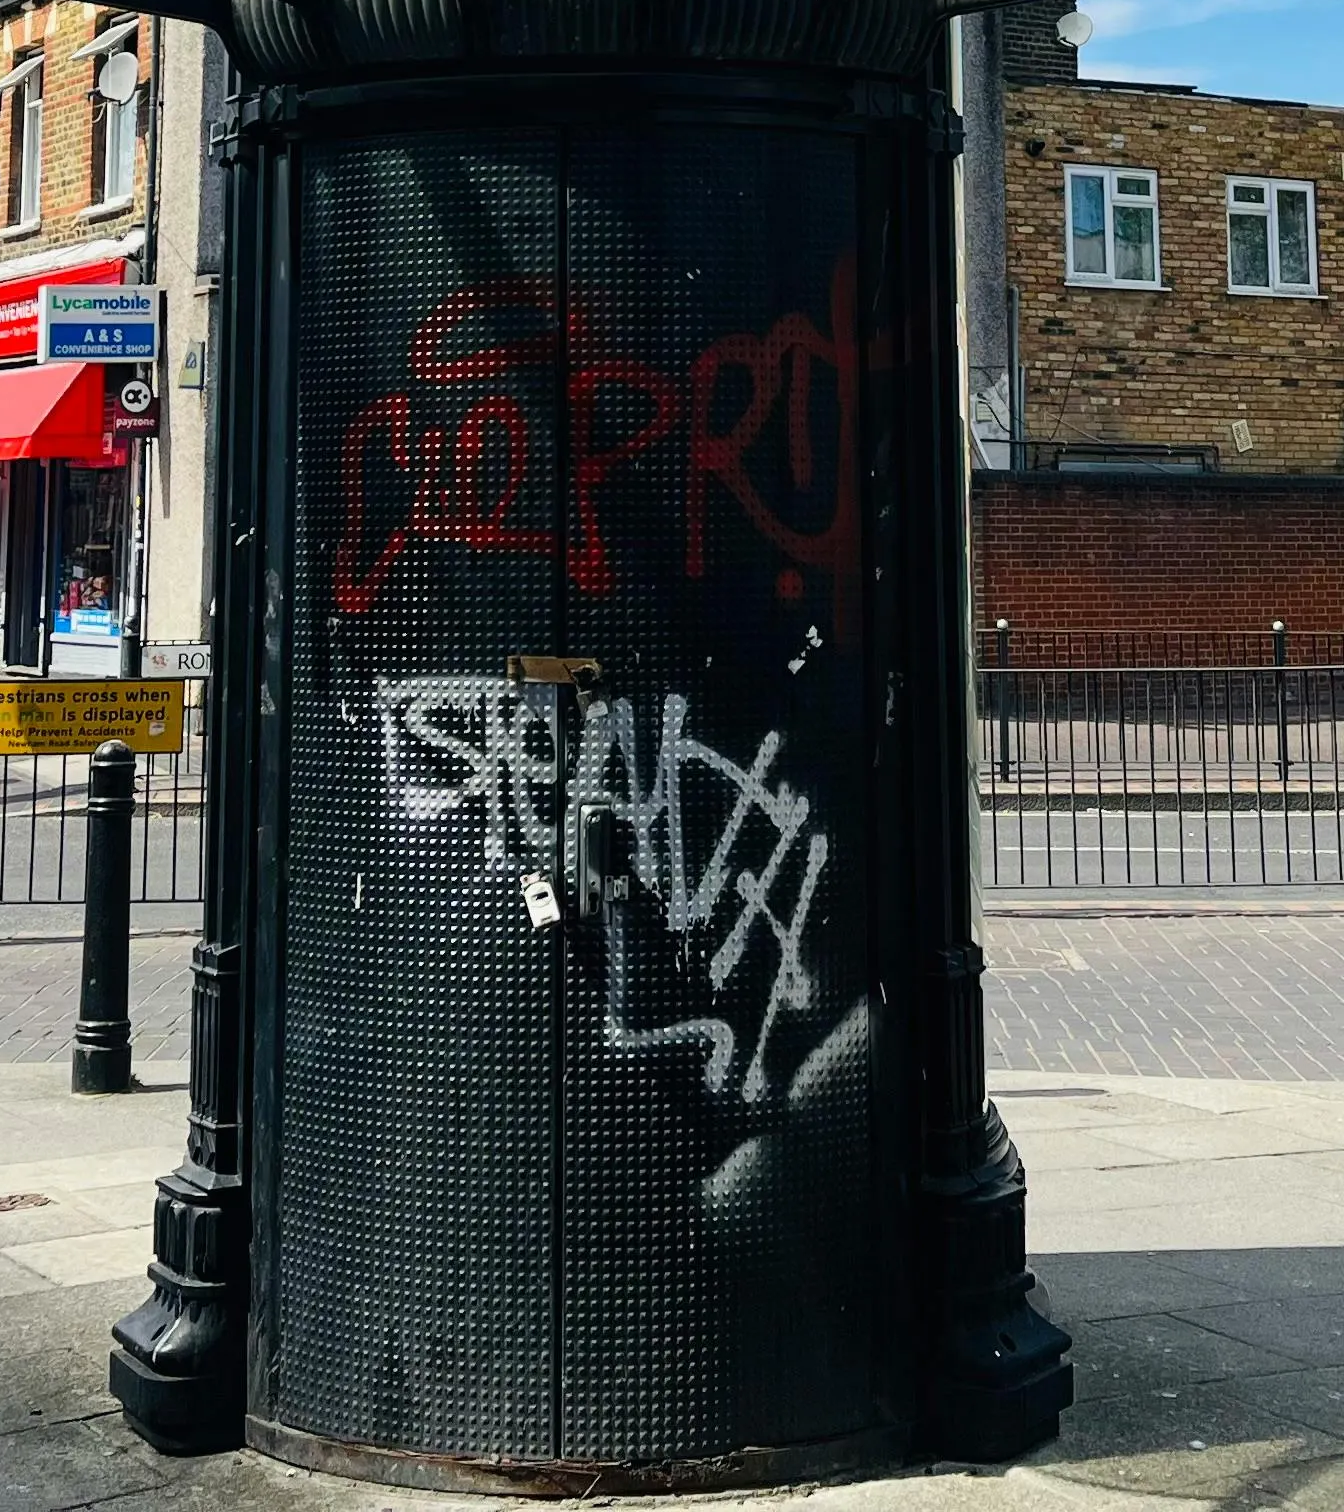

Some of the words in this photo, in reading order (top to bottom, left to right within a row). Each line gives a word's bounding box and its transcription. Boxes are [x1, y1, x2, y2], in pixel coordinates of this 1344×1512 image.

[52, 293, 151, 312] Lycamobile
[84, 328, 95, 343] A
[98, 328, 109, 343] &
[113, 328, 123, 343] S
[54, 344, 123, 355] CONVENIENCE
[125, 344, 152, 355] SHOP
[116, 417, 156, 429] payzone
[72, 691, 118, 703] cross
[125, 688, 170, 703] when
[19, 710, 54, 722] man
[62, 707, 76, 721] is
[28, 727, 74, 737] Prevent
[78, 726, 136, 737] Accidents
